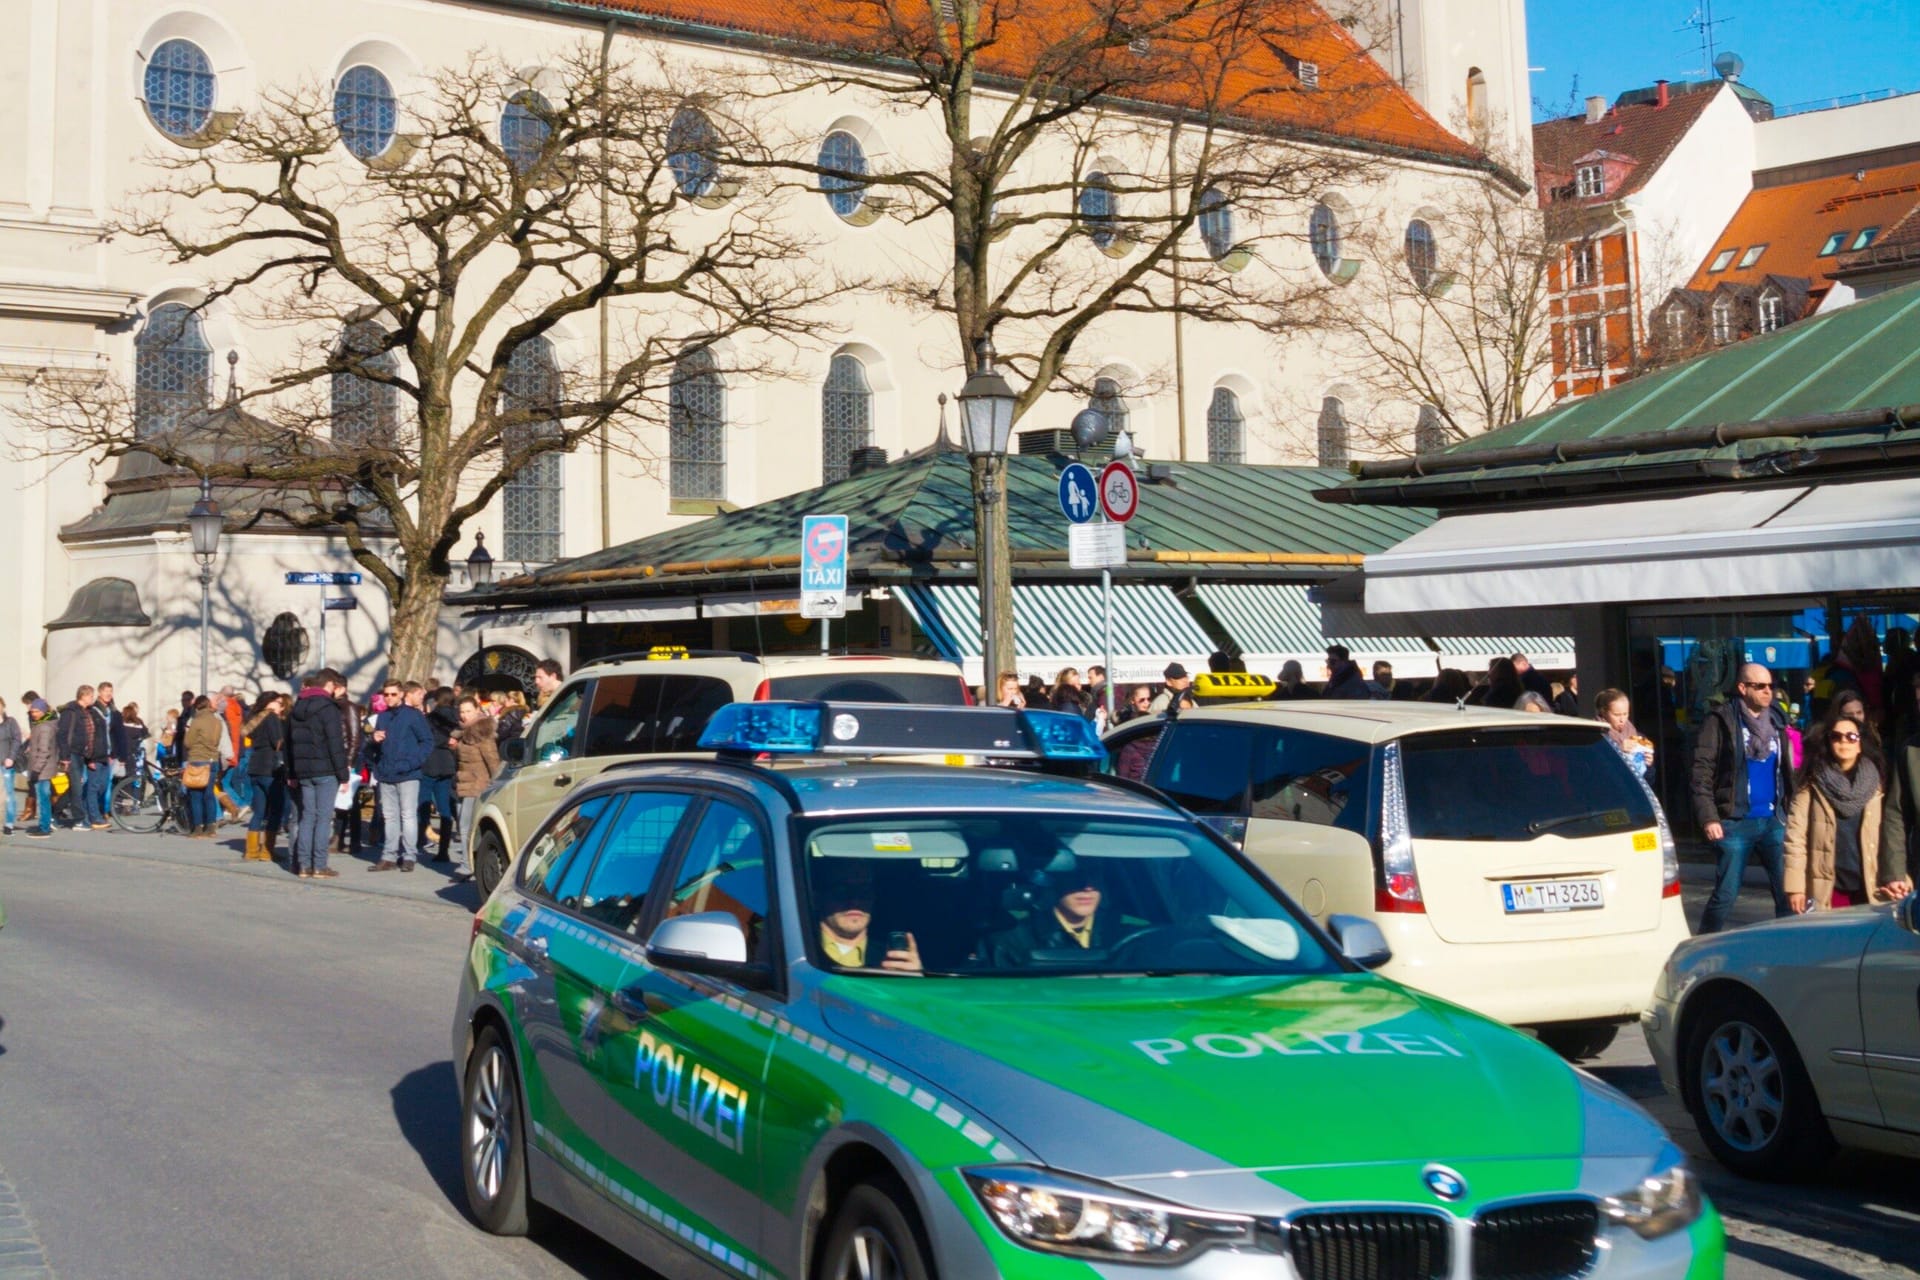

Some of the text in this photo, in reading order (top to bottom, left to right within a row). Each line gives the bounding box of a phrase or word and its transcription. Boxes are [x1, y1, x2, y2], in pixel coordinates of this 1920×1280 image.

[806, 568, 841, 585] TAXI
[1214, 674, 1267, 686] TAXI
[1514, 888, 1527, 905] M
[1560, 884, 1600, 903] 3236
[1130, 1031, 1464, 1065] POLIZEI
[634, 1031, 748, 1155] POLIZEI
